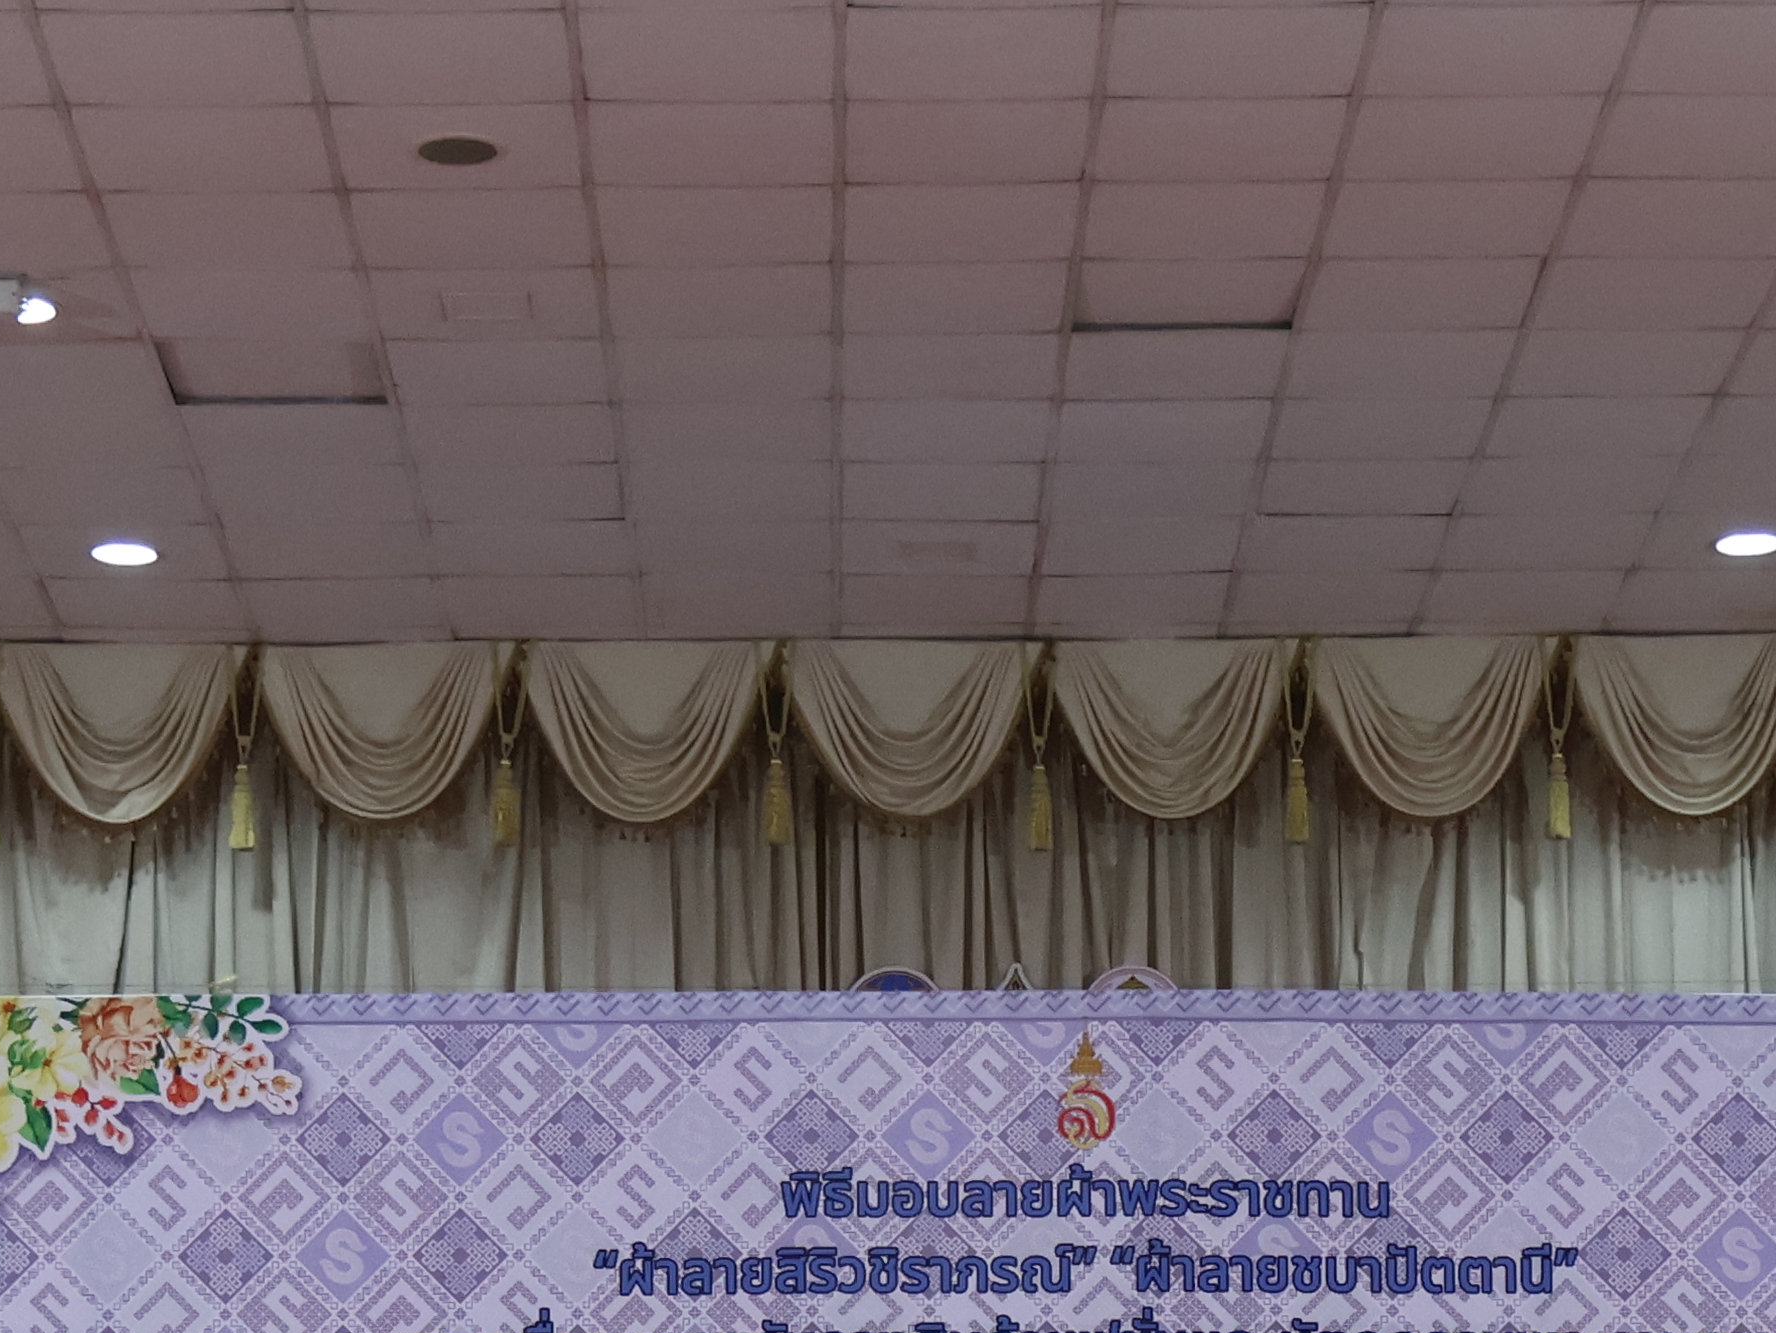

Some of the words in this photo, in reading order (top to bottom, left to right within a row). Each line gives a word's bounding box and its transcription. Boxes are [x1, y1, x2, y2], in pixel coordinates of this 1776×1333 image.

[781, 1163, 1391, 1219] พิธีมอบลายผ้าพระราชทาน
